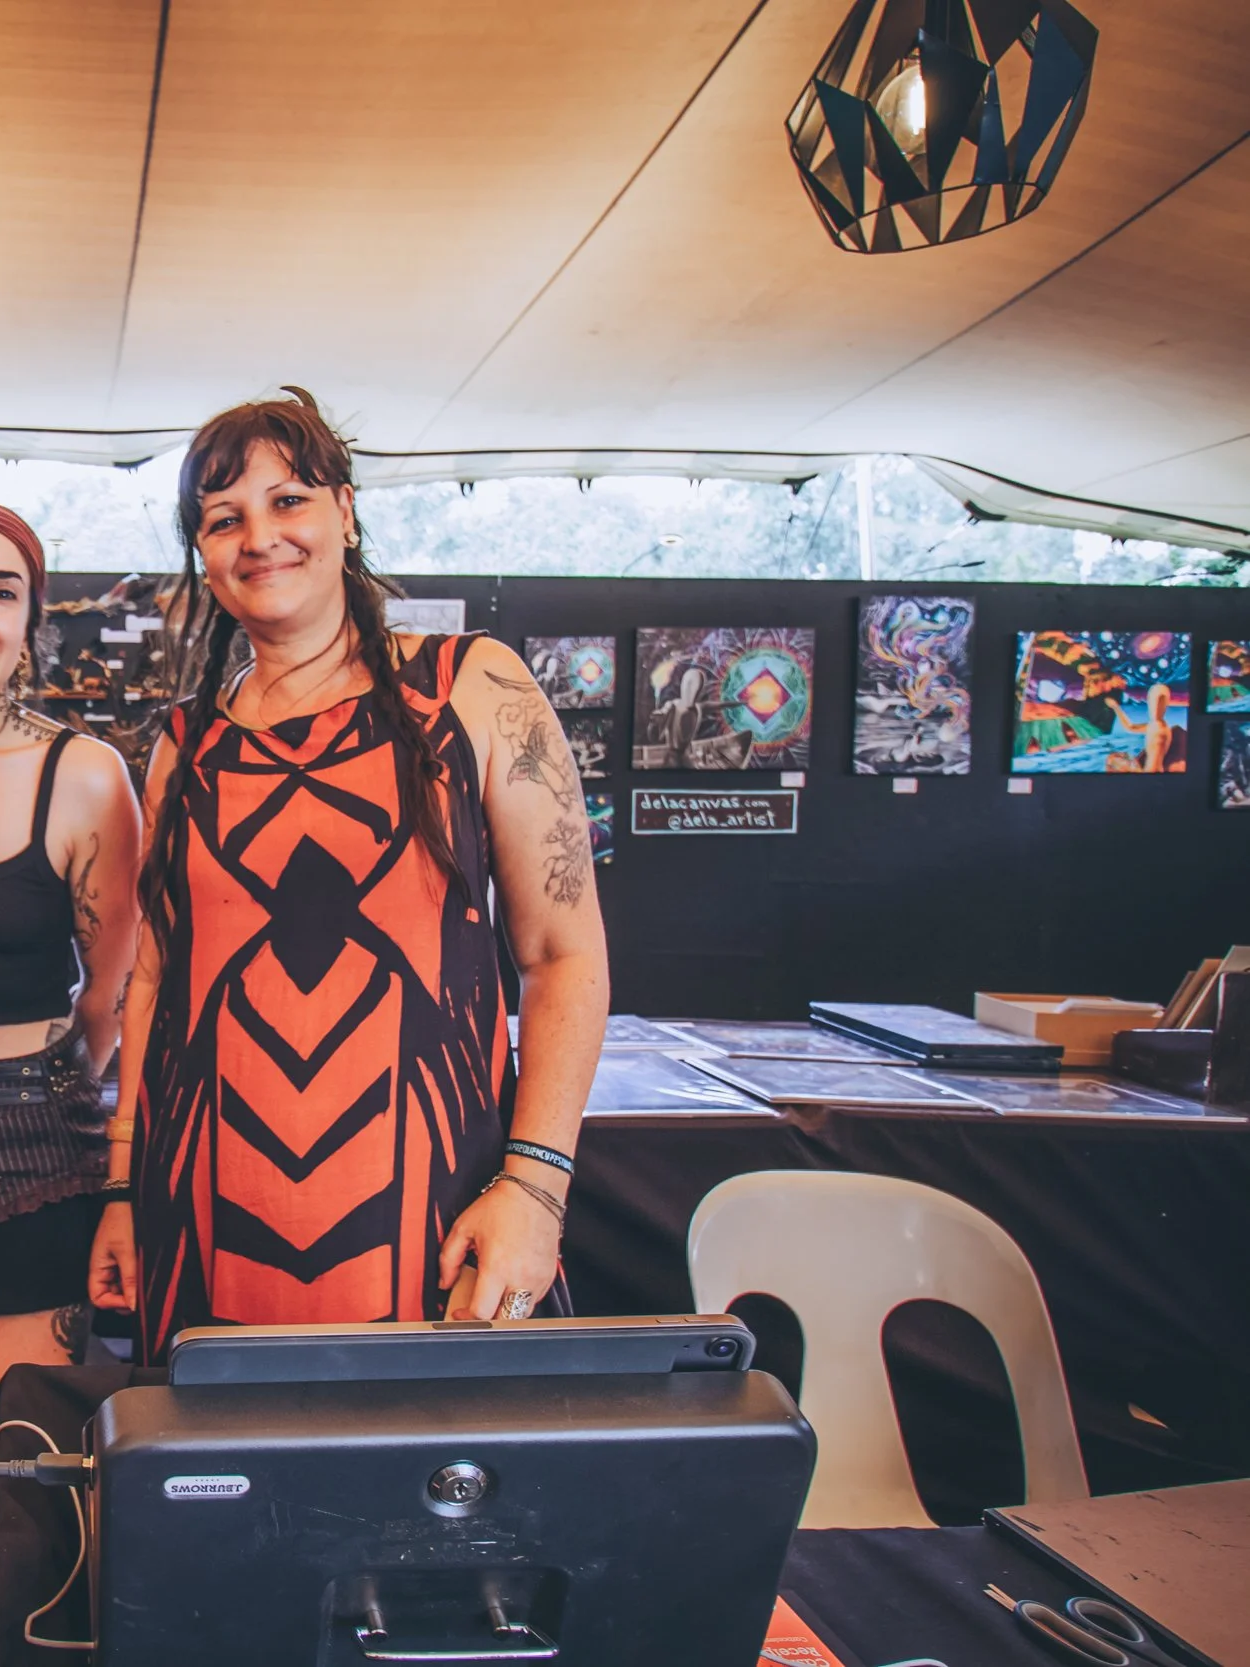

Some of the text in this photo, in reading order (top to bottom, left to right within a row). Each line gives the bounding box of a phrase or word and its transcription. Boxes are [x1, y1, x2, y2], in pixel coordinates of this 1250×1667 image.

[640, 793, 770, 810] delacanvas.com
[668, 810, 776, 830] @dela_artist
[171, 1484, 244, 1493] J.BURROWS
[764, 1647, 823, 1658] Receip
